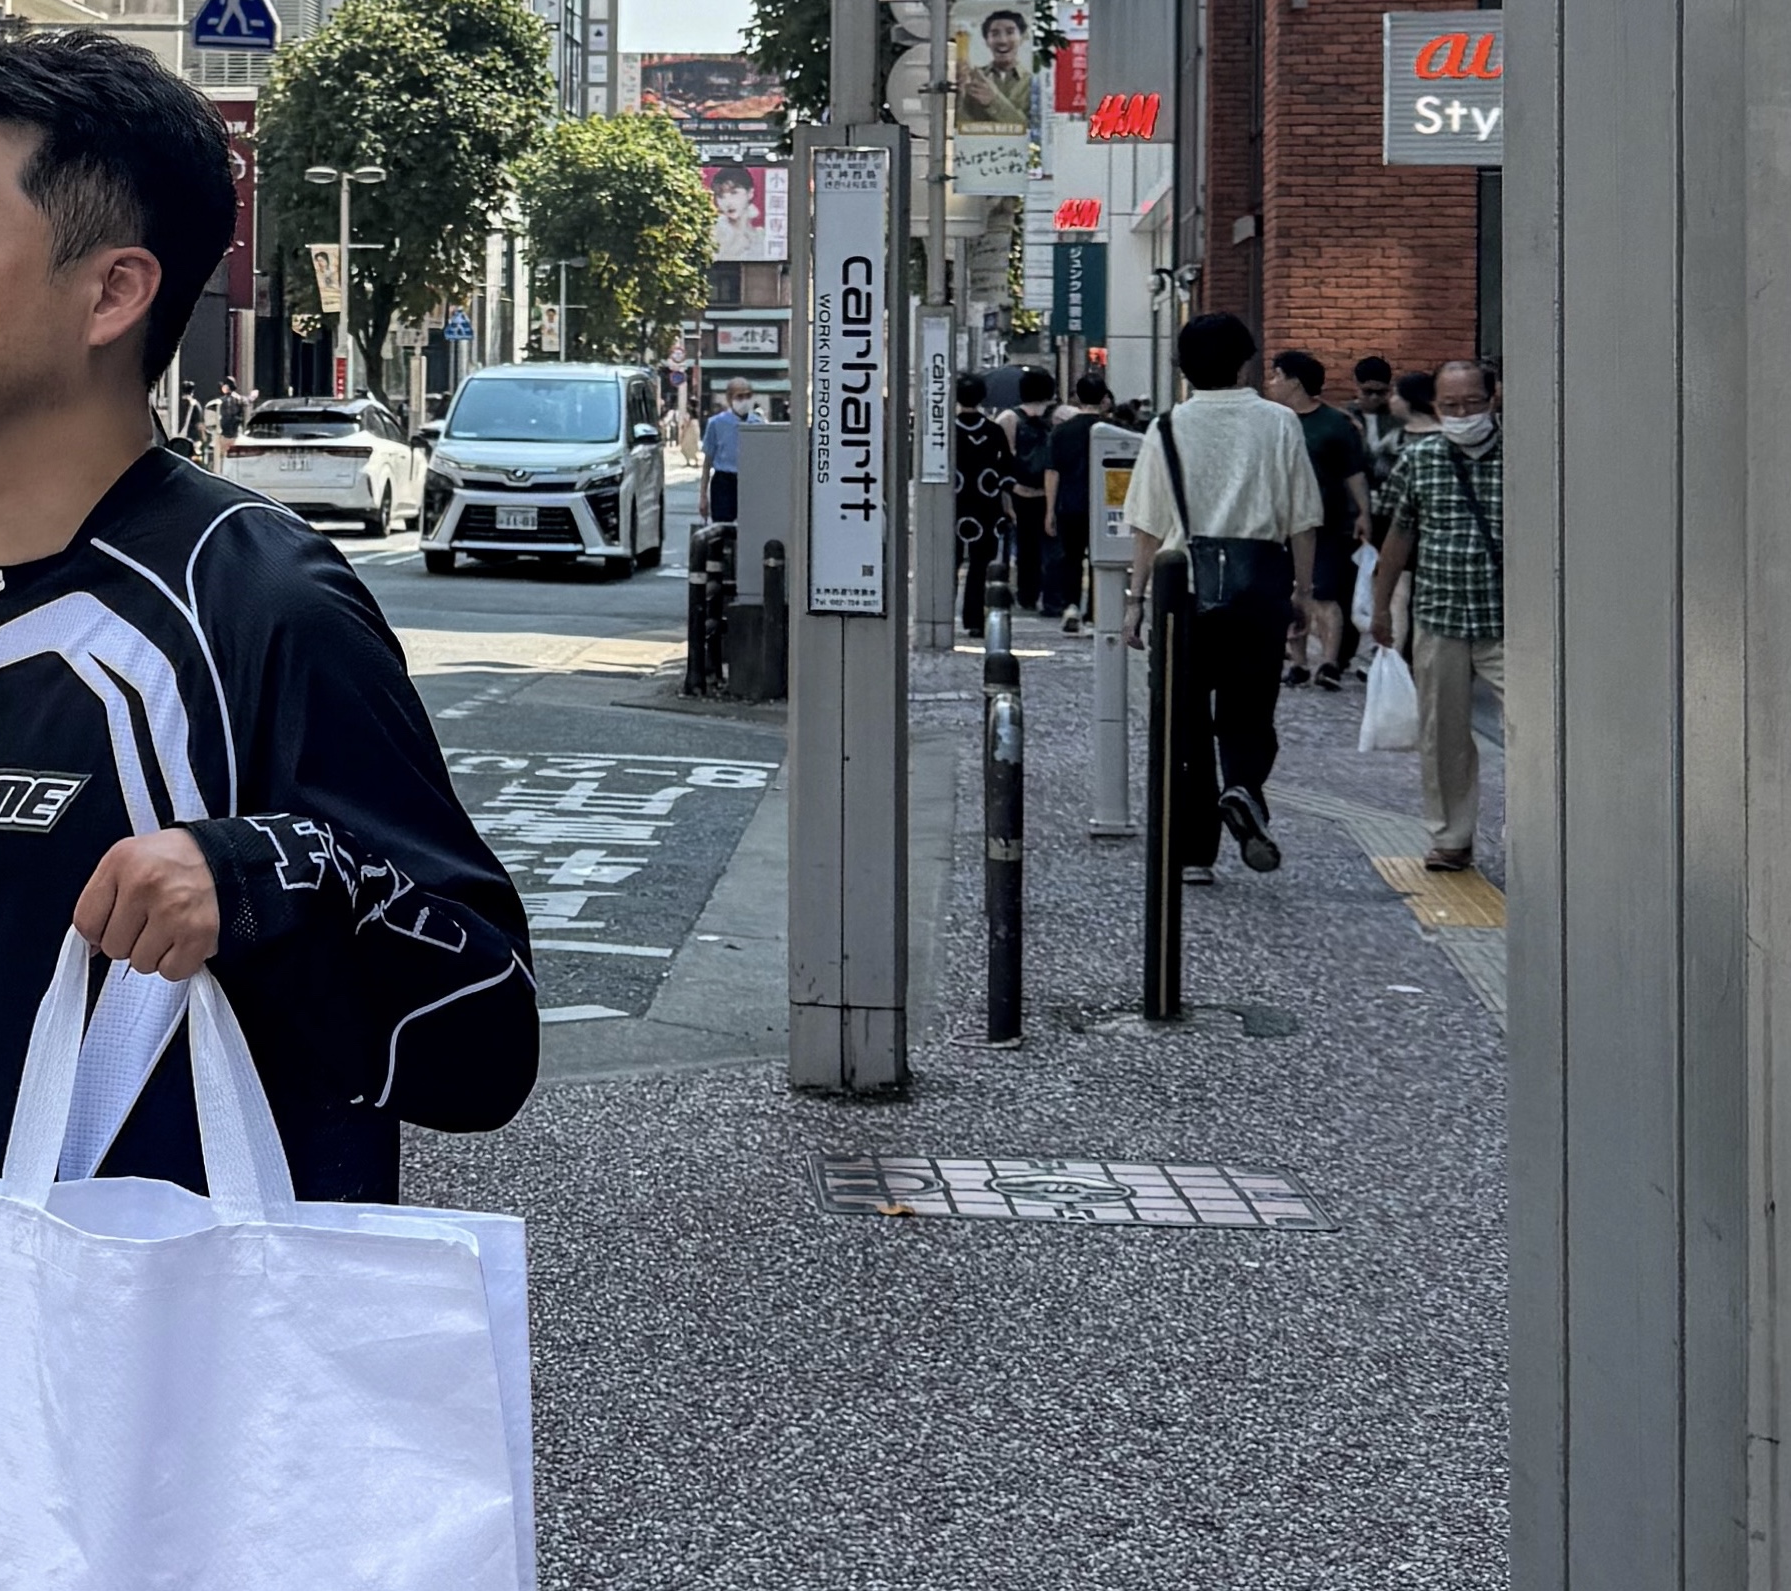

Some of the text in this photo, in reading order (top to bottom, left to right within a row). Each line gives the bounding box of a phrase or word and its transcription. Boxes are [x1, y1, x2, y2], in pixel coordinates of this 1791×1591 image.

[1413, 31, 1504, 80] au
[1413, 95, 1501, 142] Sty
[816, 293, 831, 485] WORK IN PROGRESS
[840, 255, 878, 522] carhartt
[931, 352, 946, 451] carhartt
